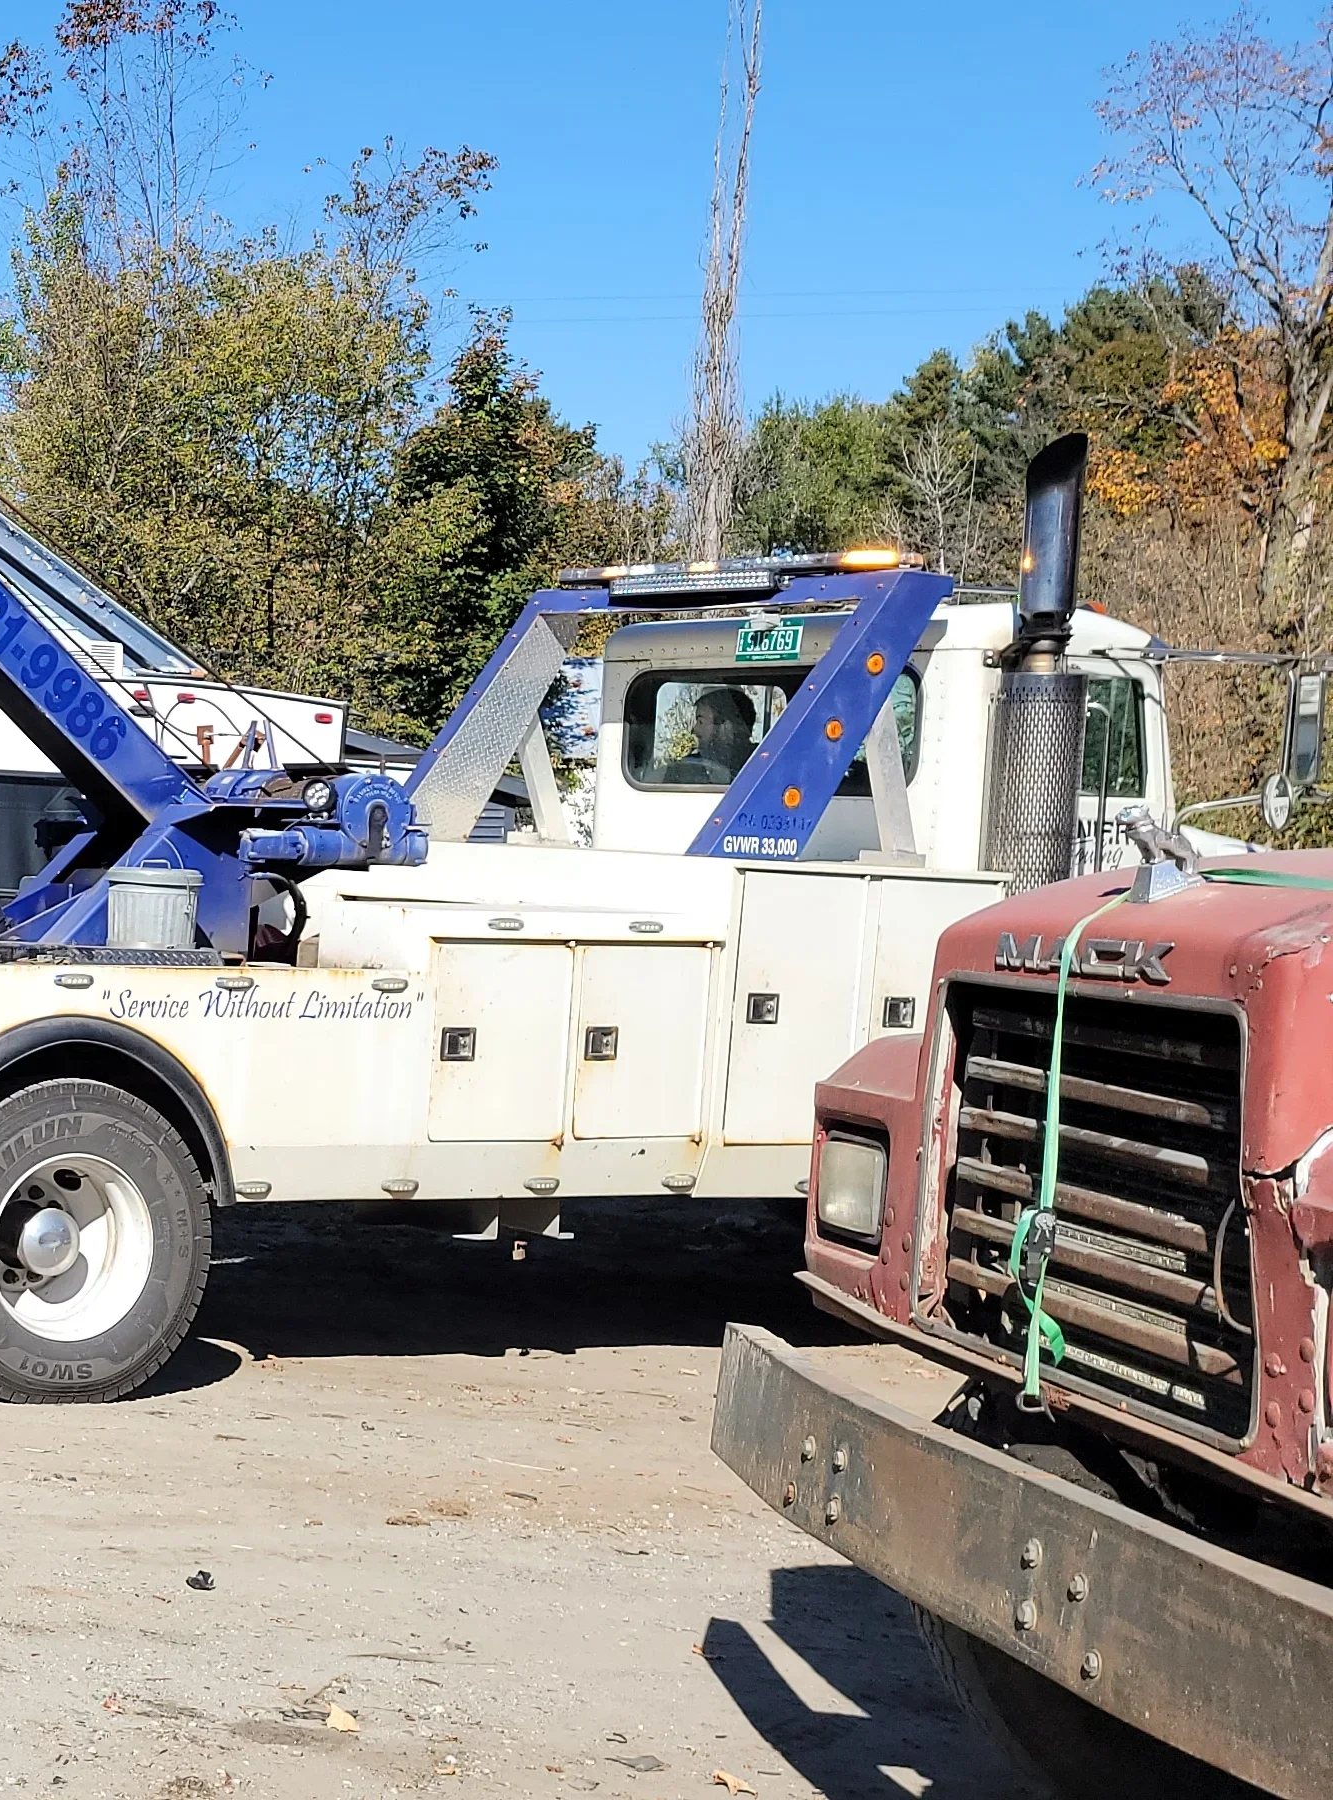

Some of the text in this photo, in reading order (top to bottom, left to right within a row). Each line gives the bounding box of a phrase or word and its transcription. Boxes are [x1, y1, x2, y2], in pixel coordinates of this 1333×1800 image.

[746, 629, 794, 652] 916769
[723, 835, 798, 858] GVWR 33,000
[994, 931, 1176, 986] MACK
[101, 984, 425, 1019] "Service Without Limitation"
[18, 1354, 94, 1381] SW01
